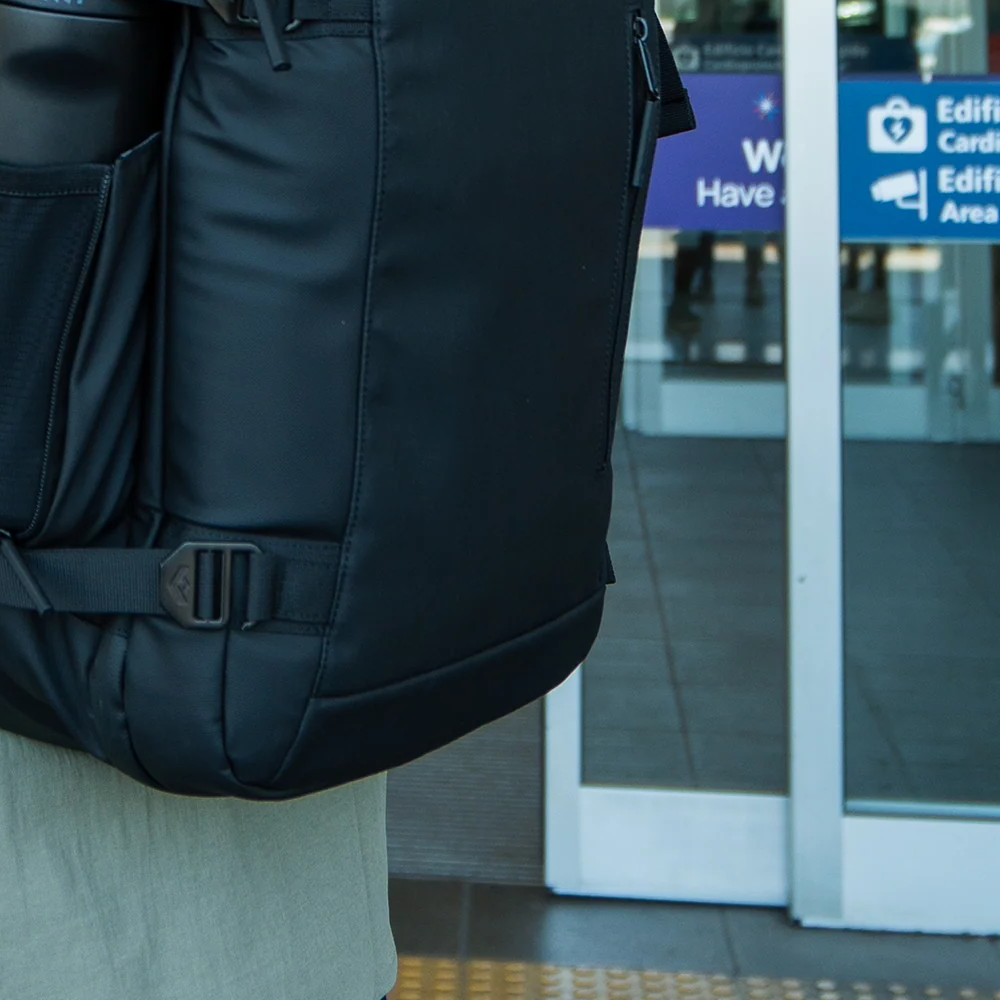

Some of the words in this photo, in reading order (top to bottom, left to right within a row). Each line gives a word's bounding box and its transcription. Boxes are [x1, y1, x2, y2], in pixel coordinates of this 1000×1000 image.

[741, 137, 786, 173] W
[697, 177, 776, 208] Have
[940, 199, 999, 223] Area
